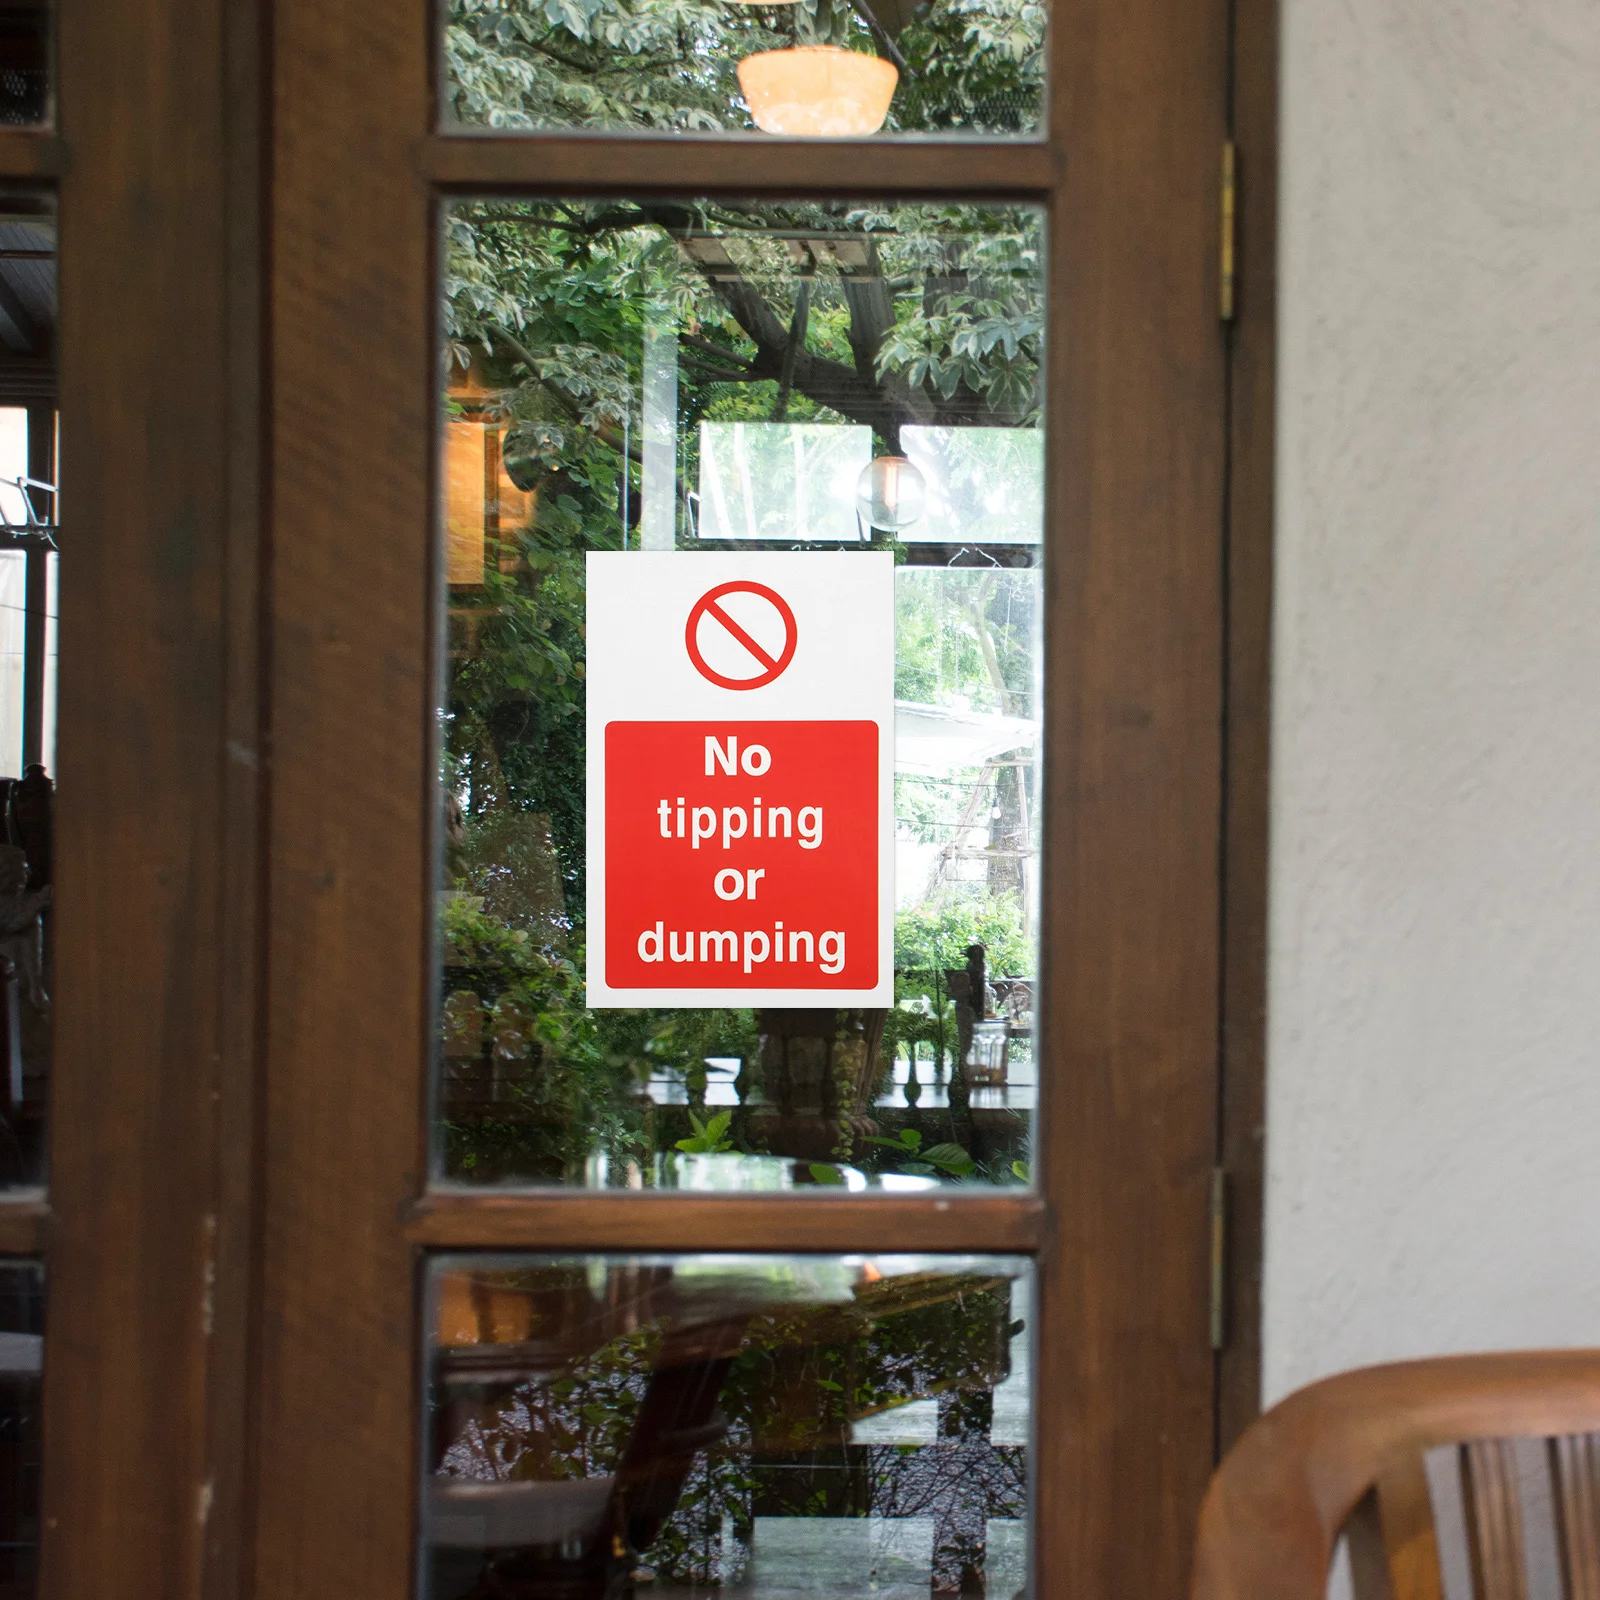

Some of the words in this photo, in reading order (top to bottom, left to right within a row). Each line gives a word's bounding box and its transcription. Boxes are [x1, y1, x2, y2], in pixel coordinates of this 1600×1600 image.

[704, 735, 772, 777] No
[656, 796, 823, 850] tipping
[713, 868, 766, 901] or
[637, 921, 846, 975] dumping
